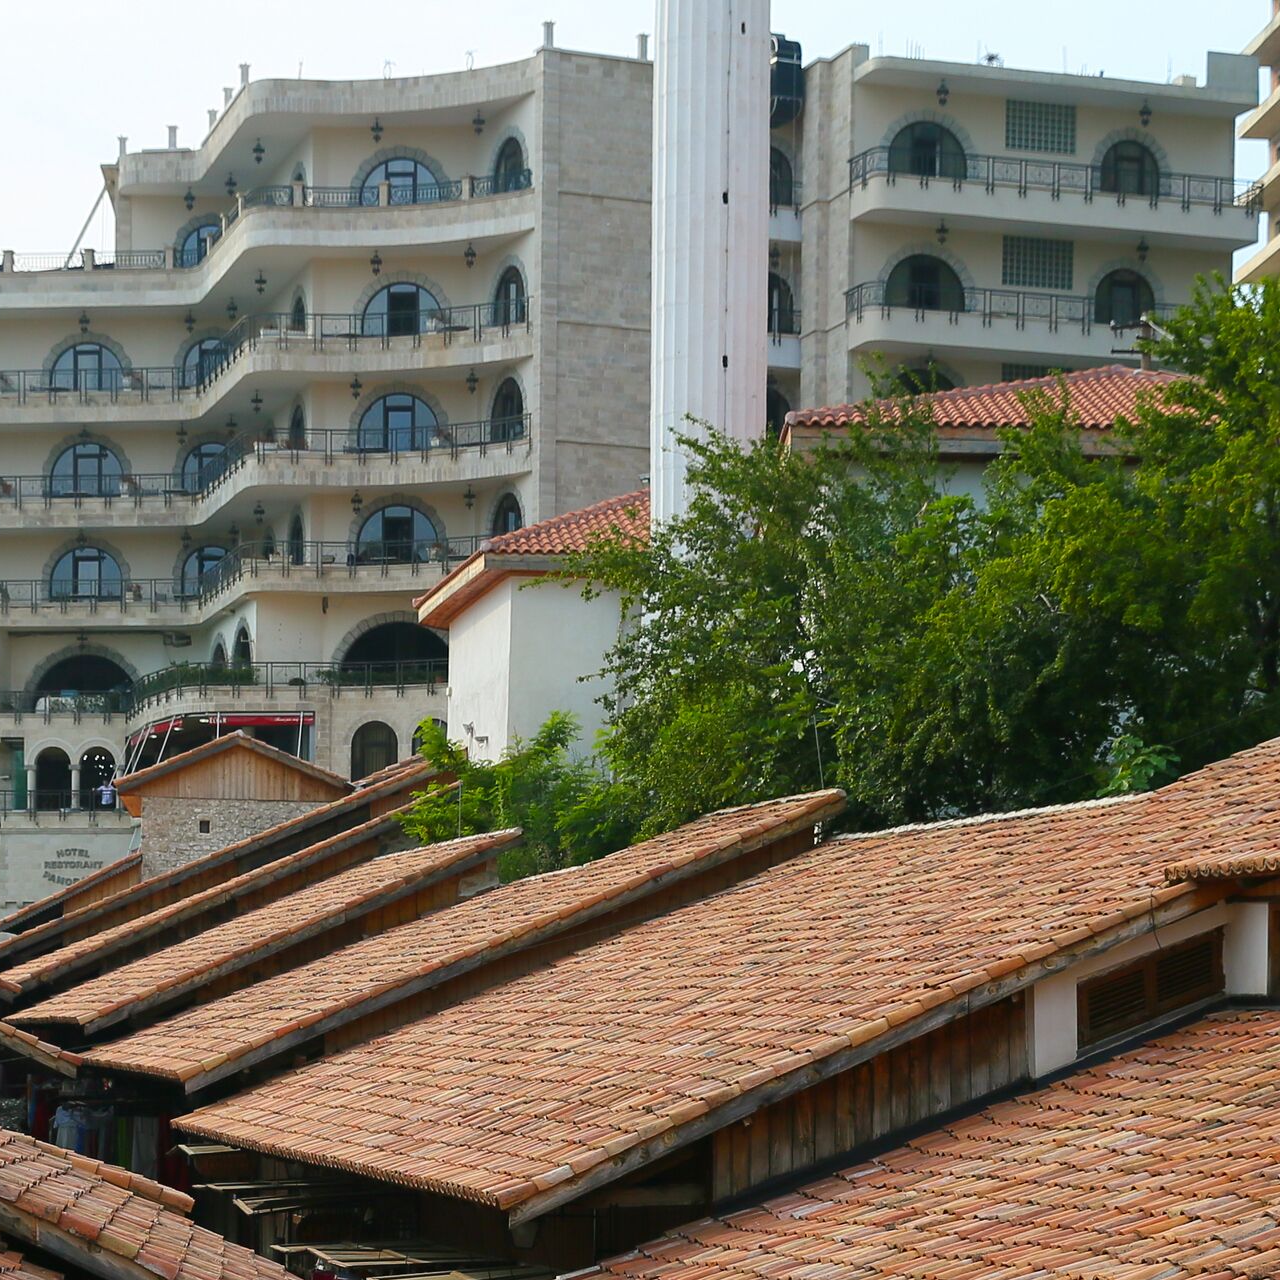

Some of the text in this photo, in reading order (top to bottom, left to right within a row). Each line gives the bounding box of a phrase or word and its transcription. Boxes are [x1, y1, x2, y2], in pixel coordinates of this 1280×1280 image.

[56, 848, 90, 859] HOTEL
[44, 861, 103, 869] RESTORANT
[42, 870, 84, 886] PANOR
